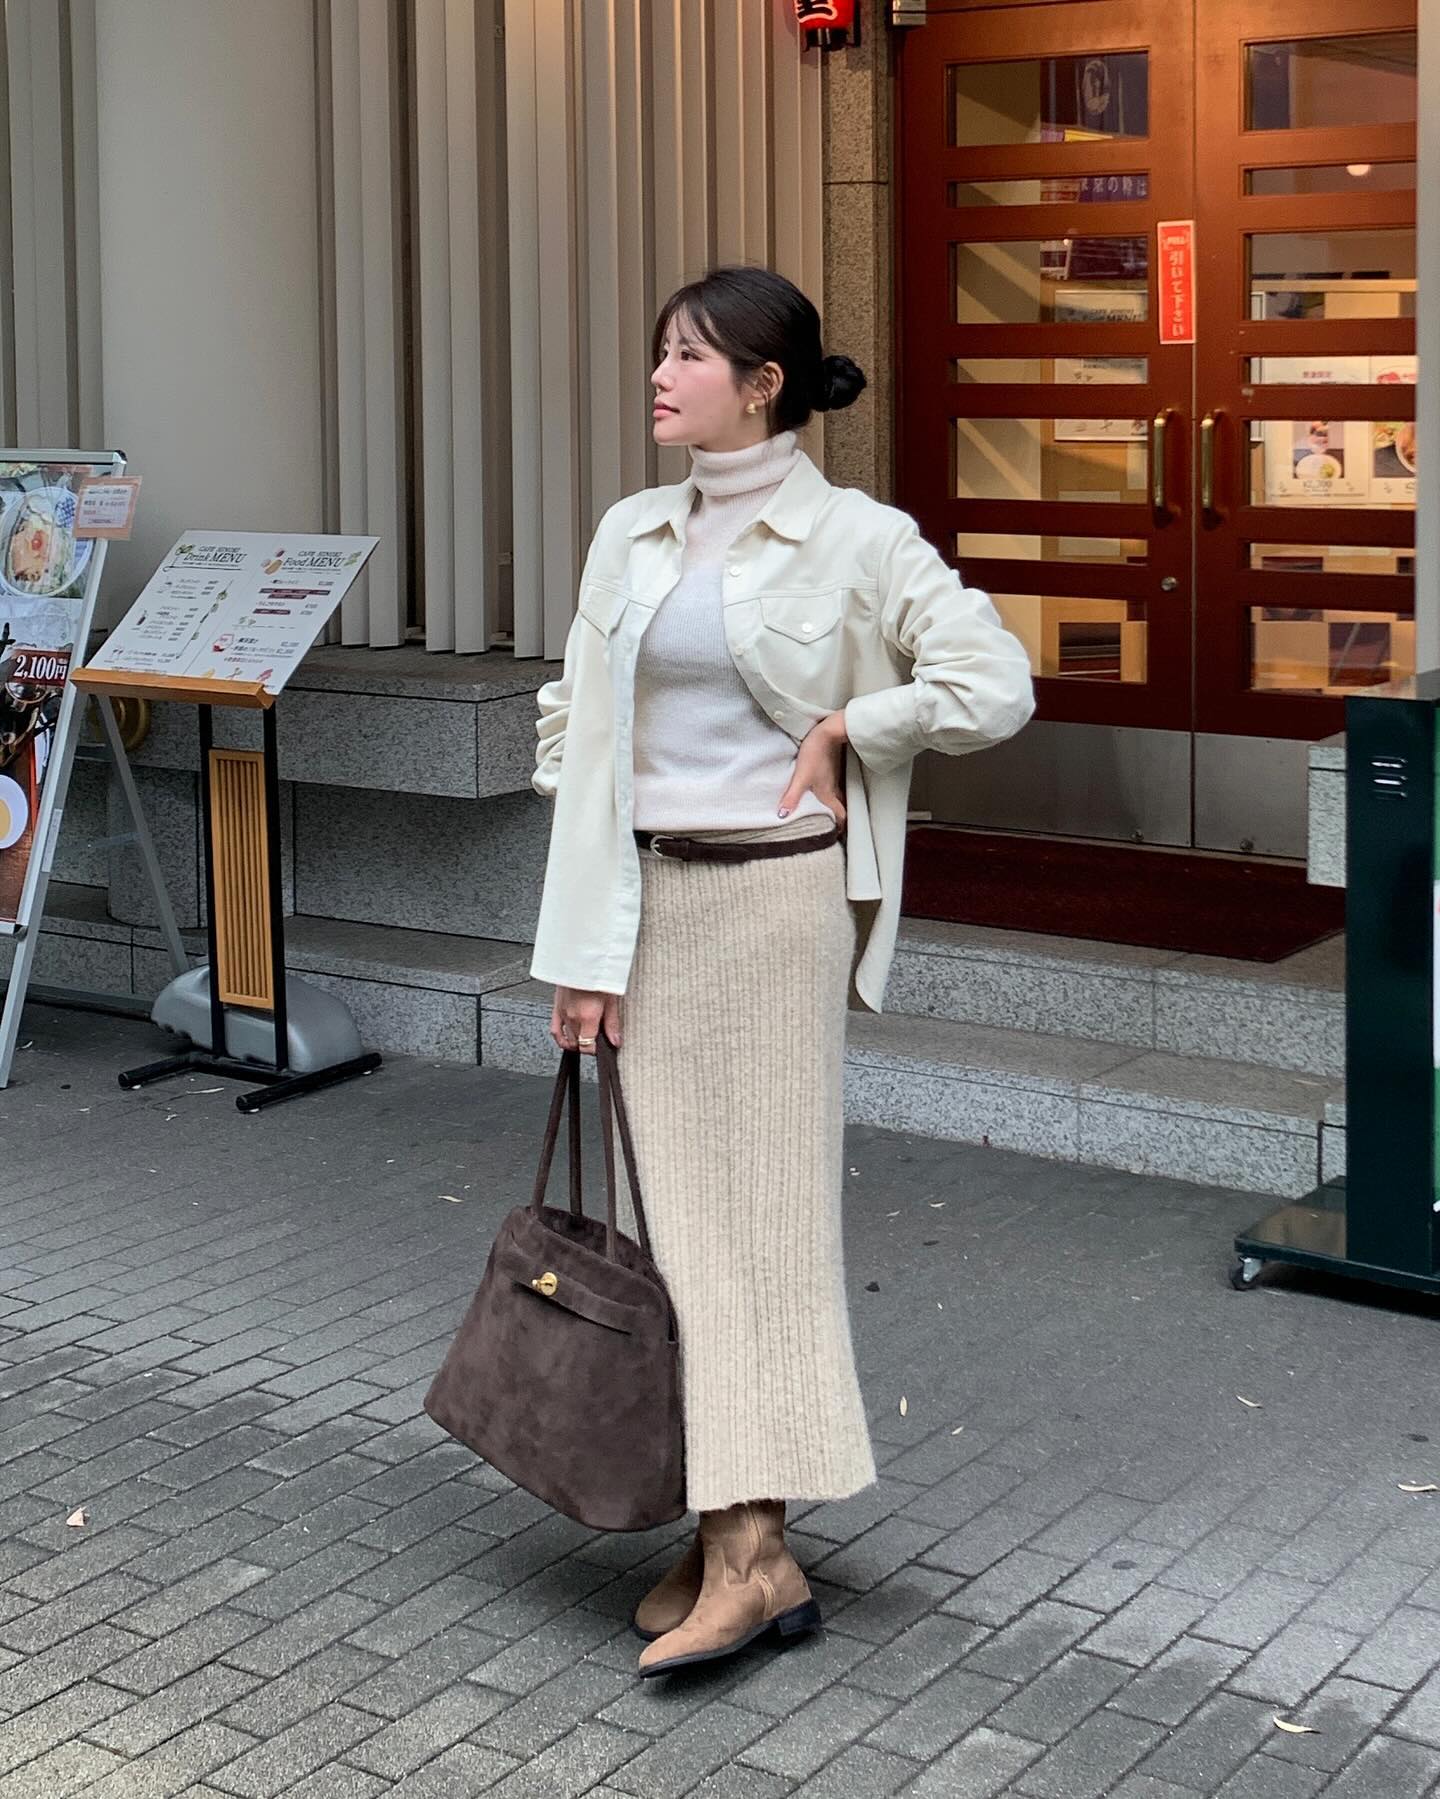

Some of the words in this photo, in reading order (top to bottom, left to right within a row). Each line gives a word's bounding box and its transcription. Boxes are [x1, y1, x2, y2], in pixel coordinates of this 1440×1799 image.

[1169, 250, 1185, 337] 引いて下さい
[184, 552, 209, 562] Drink
[208, 553, 247, 564] MENU
[284, 557, 308, 567] Food
[306, 557, 346, 568] MENU
[13, 655, 68, 680] 2,100円
